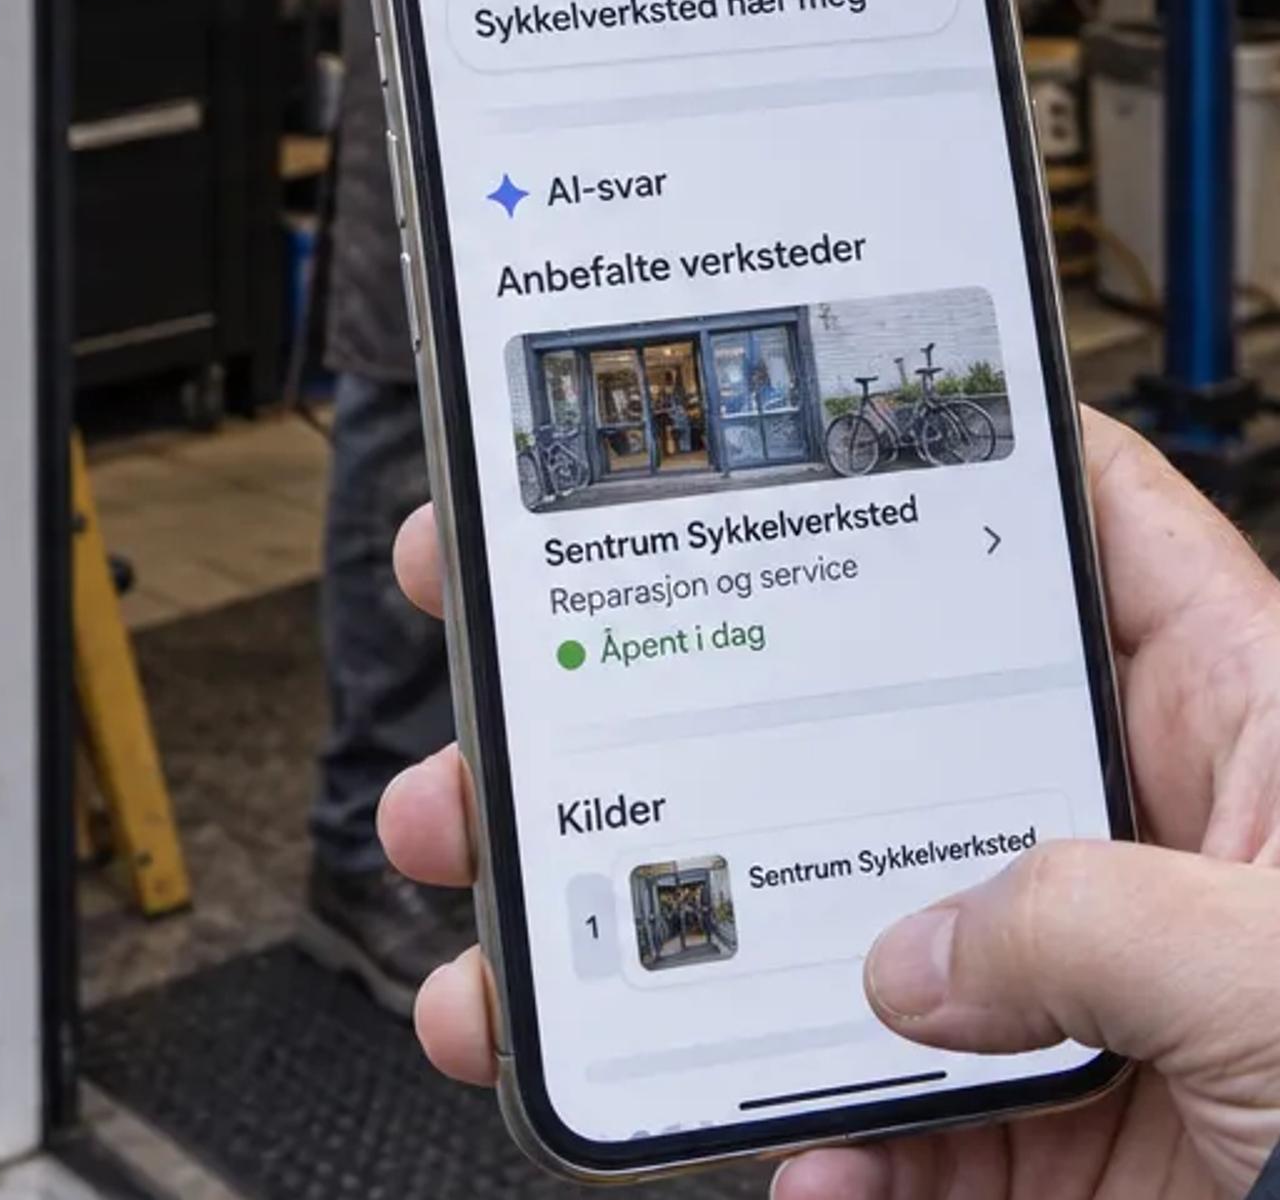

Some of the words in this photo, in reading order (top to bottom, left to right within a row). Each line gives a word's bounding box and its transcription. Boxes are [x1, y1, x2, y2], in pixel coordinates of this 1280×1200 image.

[547, 173, 668, 207] AI-svar
[496, 252, 671, 298] Anbefalte
[679, 232, 867, 279] verksteder
[544, 531, 680, 567] Sentrum
[687, 493, 919, 555] Sykkelverksted
[549, 573, 709, 617] Reparasjon
[716, 571, 753, 599] og
[759, 555, 859, 589] service
[600, 627, 689, 668] Åpent
[694, 624, 704, 652] i
[711, 620, 767, 652] dag
[557, 793, 667, 836] Kilder
[748, 858, 853, 889] Sentrum
[857, 825, 1037, 877] Sykkelverksted
[585, 914, 599, 940] 1
